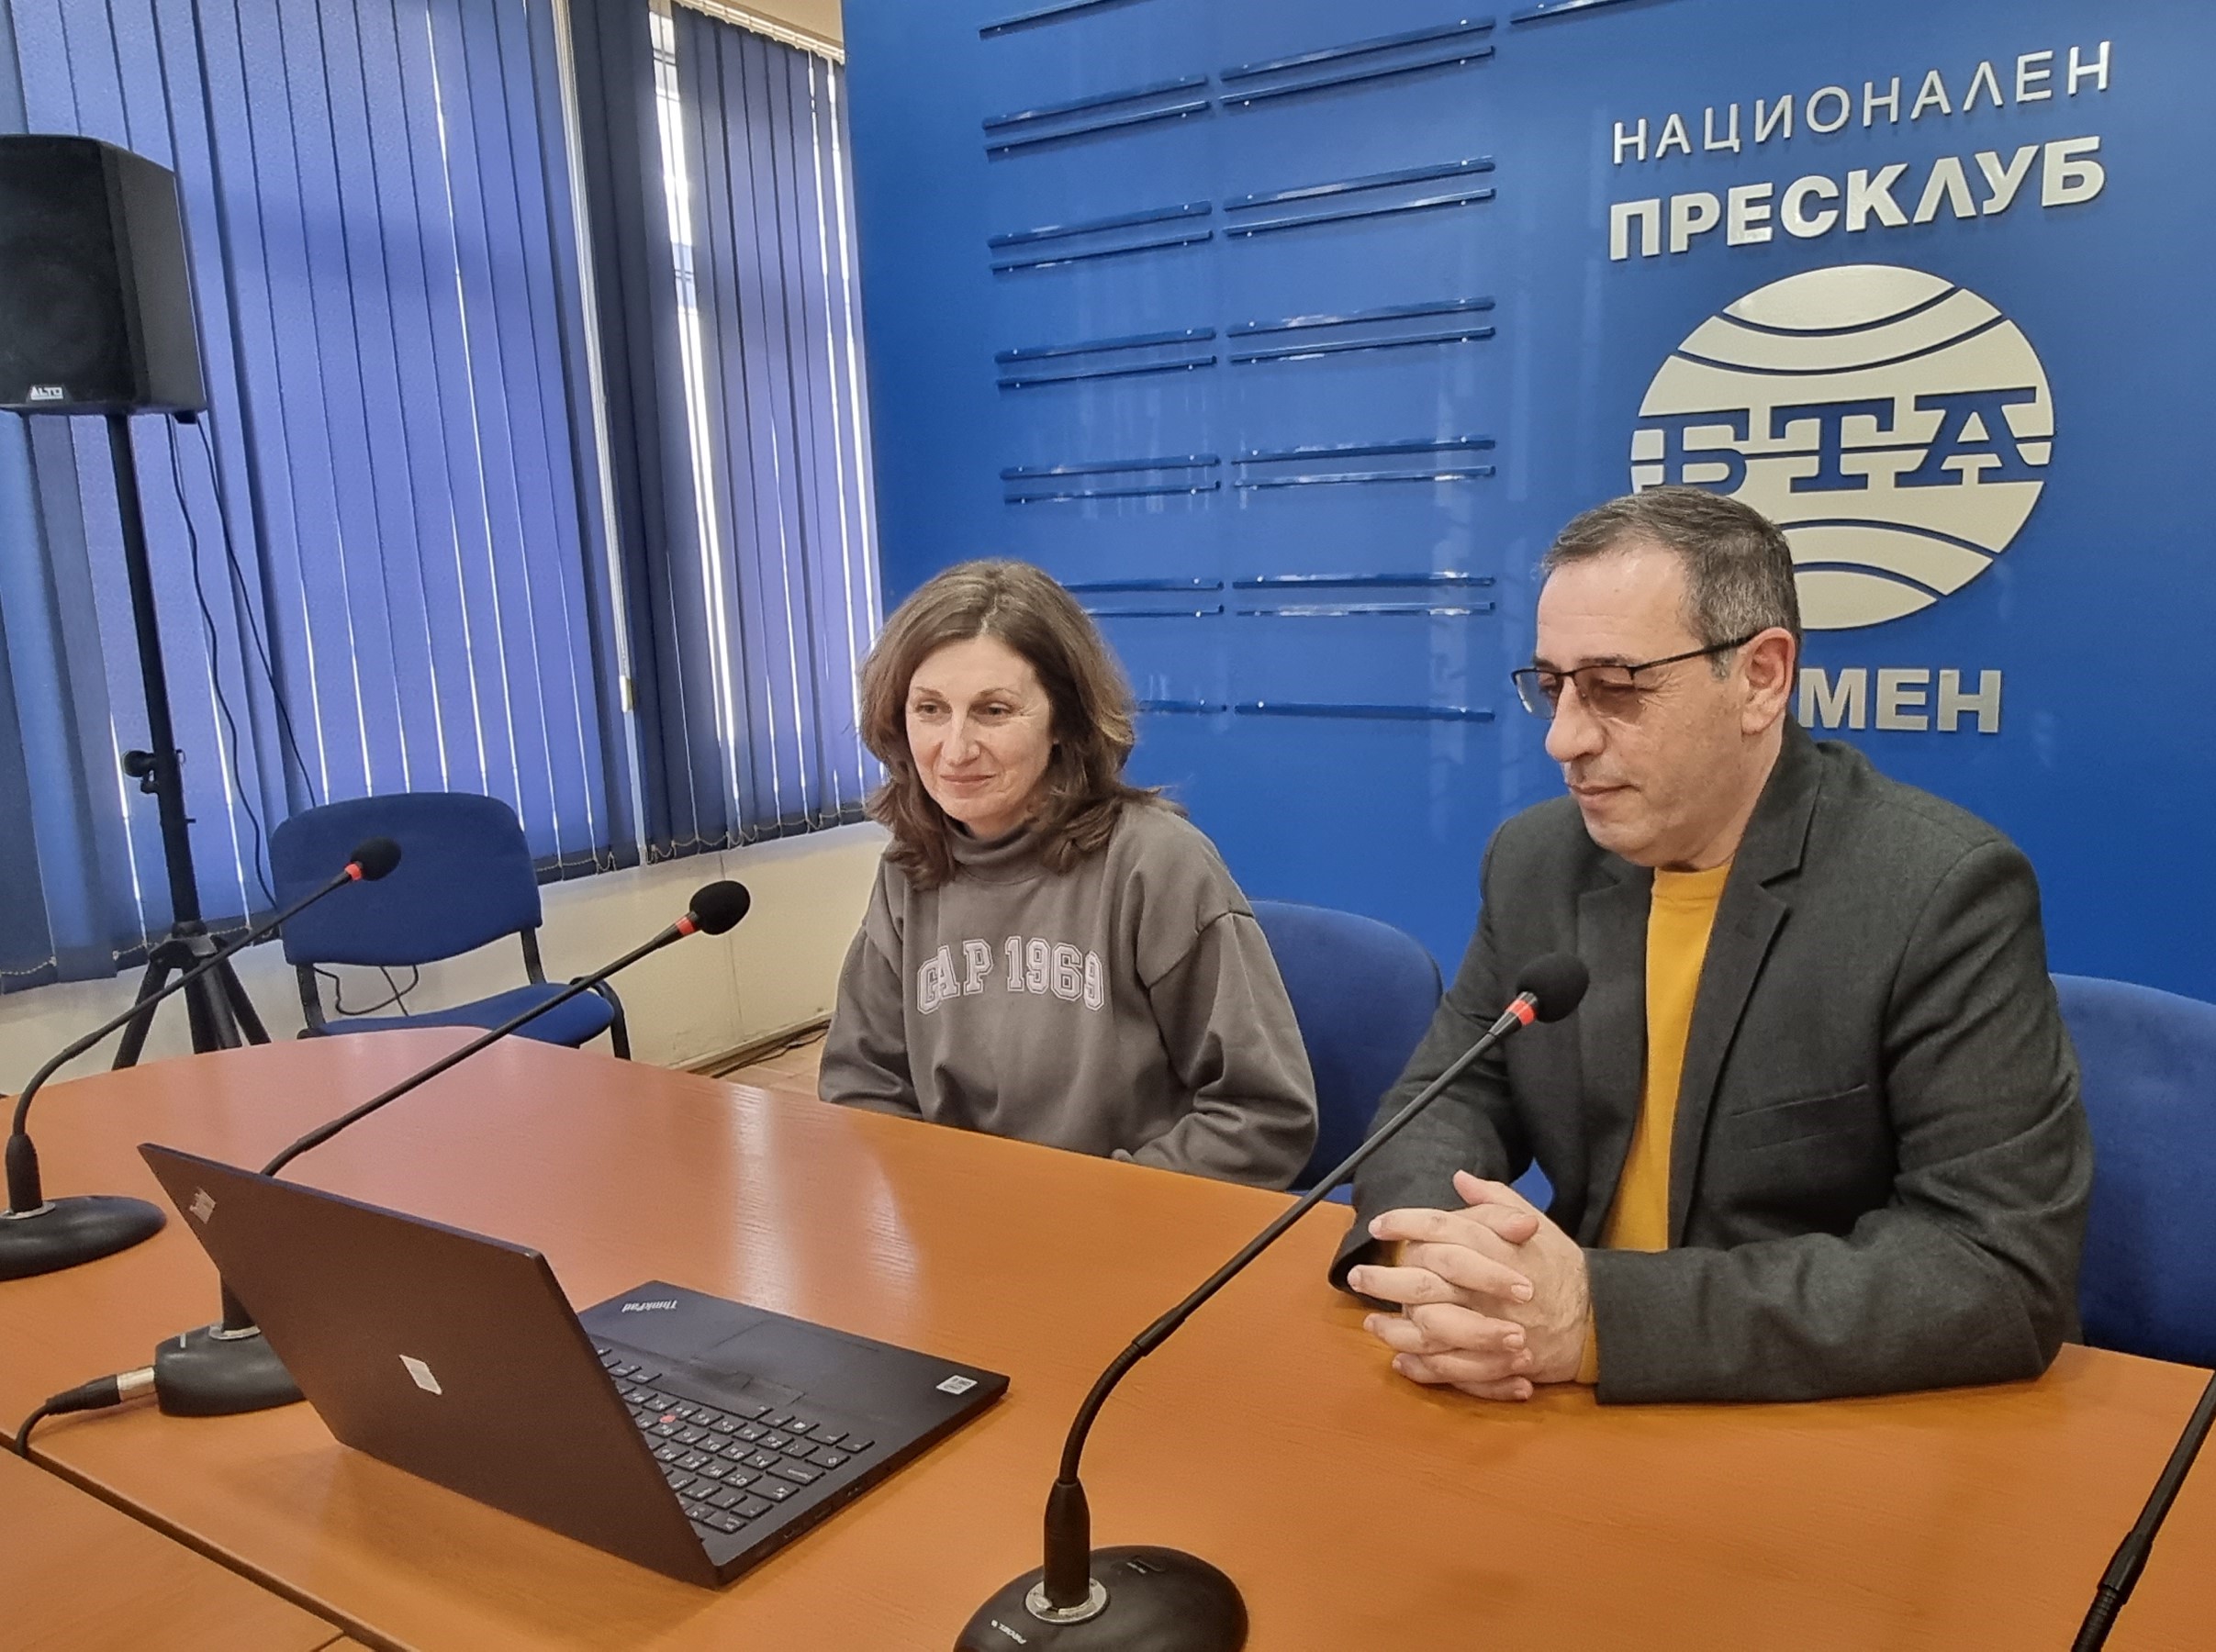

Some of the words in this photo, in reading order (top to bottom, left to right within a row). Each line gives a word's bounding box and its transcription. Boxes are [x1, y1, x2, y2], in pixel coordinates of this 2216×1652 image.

[1613, 41, 2112, 163] НАЦИОНАЛЕН
[1610, 137, 2107, 261] ПРЕСКЛУБ
[31, 385, 62, 398] ALTO
[1634, 386, 2040, 494] БТА
[1799, 668, 2002, 732] МЕН
[918, 939, 994, 1014] GAP
[1005, 935, 1104, 1010] 1969
[621, 1300, 677, 1312] ThinkPad
